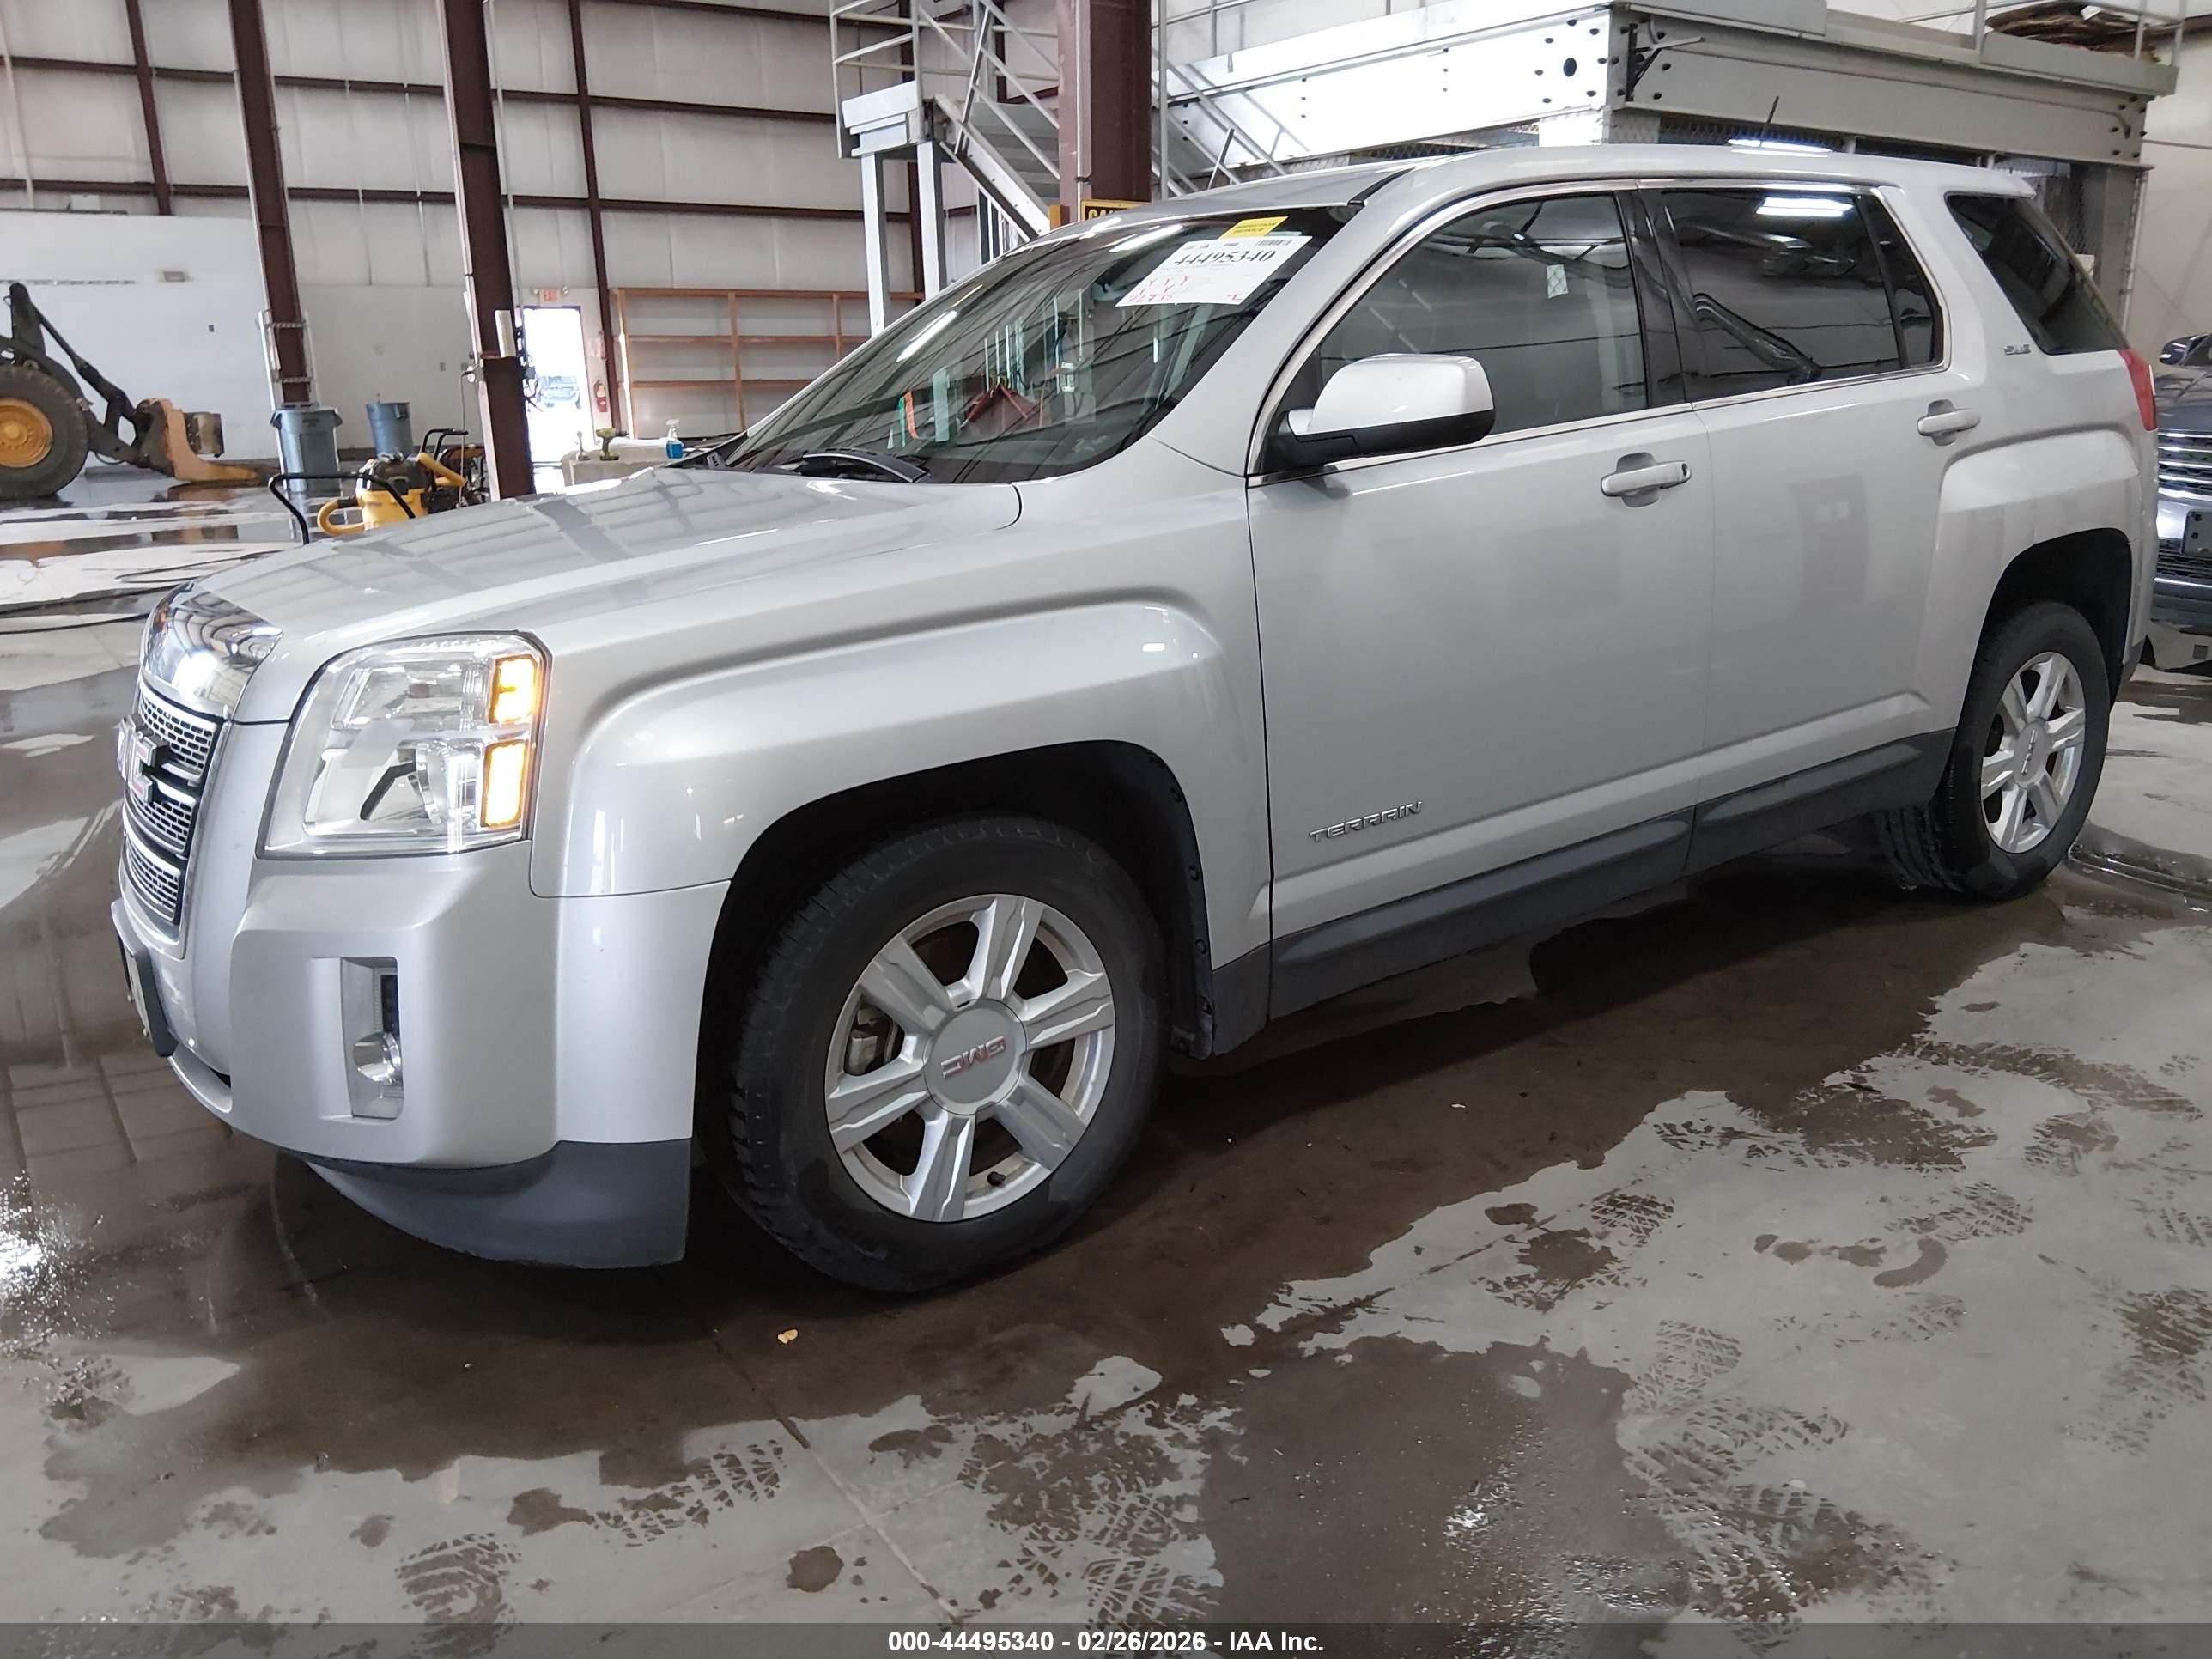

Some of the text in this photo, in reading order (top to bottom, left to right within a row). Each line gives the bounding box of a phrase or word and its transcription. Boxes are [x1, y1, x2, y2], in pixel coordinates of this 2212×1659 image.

[1175, 250, 1276, 266] 44495340
[1309, 800, 1422, 842] TERRAIN
[940, 1036, 1007, 1079] GMC
